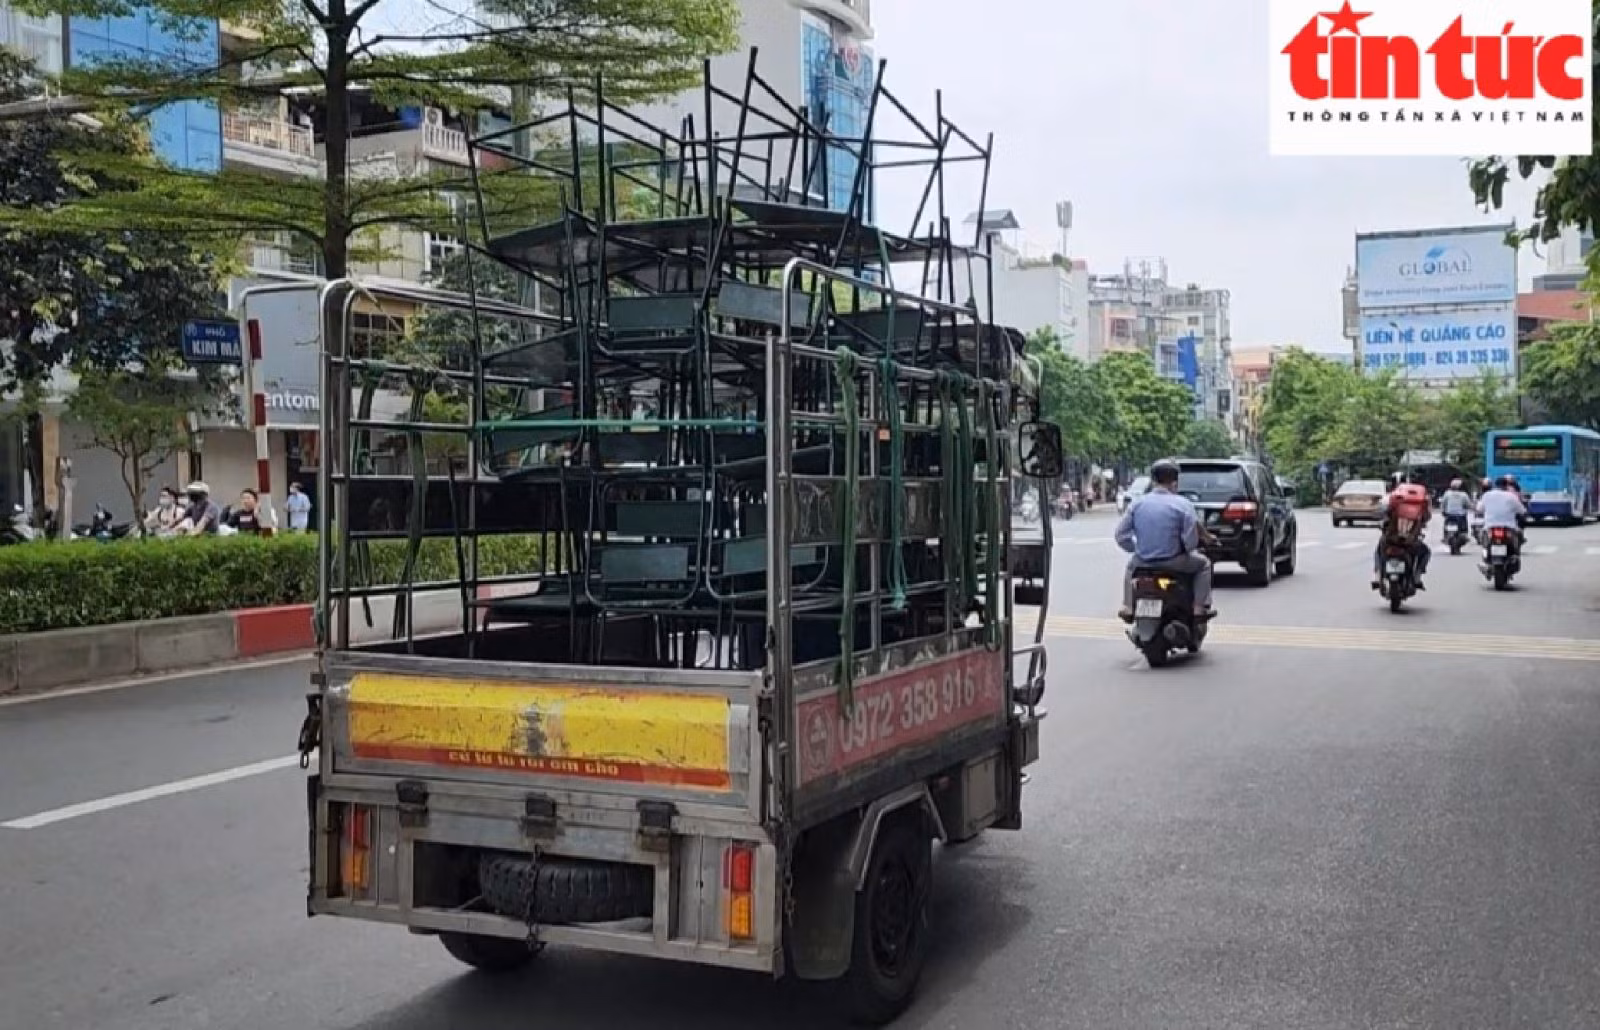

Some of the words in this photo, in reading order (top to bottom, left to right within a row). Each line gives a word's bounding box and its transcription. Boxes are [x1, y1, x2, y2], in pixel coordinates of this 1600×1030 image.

[1398, 259, 1472, 277] GLOBAL
[191, 340, 218, 356] KIM
[901, 677, 939, 729] 358
[942, 666, 975, 714] 916
